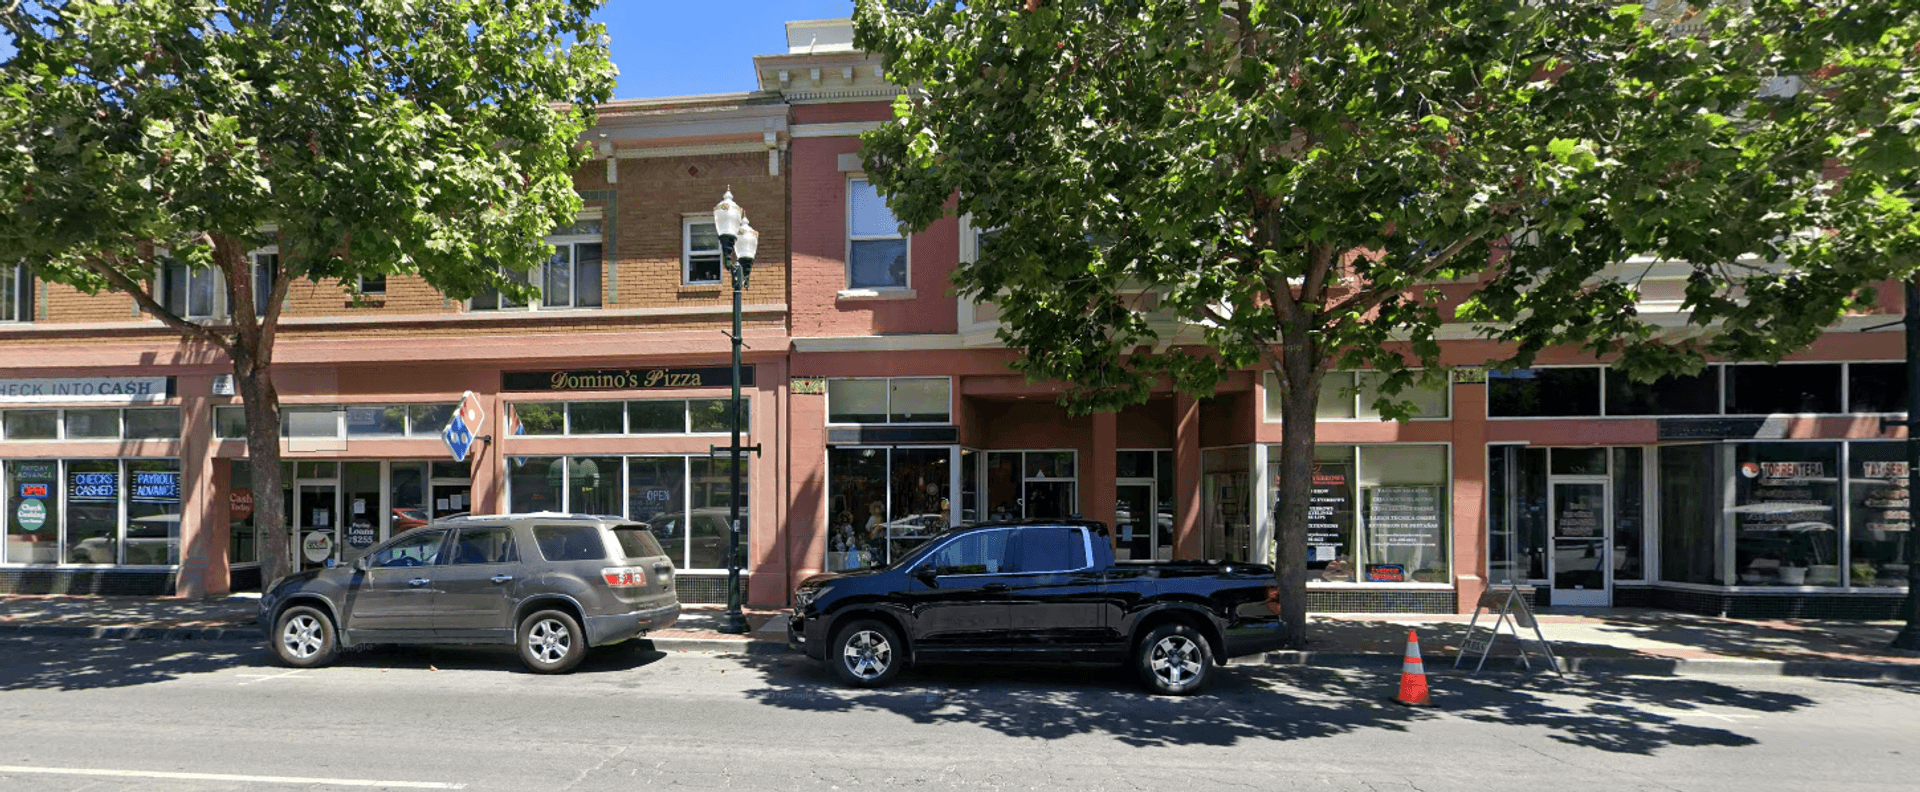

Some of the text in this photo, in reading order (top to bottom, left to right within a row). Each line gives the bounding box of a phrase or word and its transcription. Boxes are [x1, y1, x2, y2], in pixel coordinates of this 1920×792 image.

[551, 369, 702, 389] Domino's Pizza
[0, 383, 43, 395] HECK
[52, 382, 94, 395] INTO
[1761, 462, 1824, 477] TORRENTERA
[1863, 462, 1909, 477] TAX SERV
[75, 474, 113, 484] CHECKS
[137, 474, 175, 484] PAYROLL
[75, 485, 114, 496] CASHED
[137, 485, 176, 496] ADVANCE
[646, 490, 670, 501] OPEN
[230, 493, 253, 503] Cash
[349, 527, 374, 535] Loans
[352, 535, 374, 544] $255
